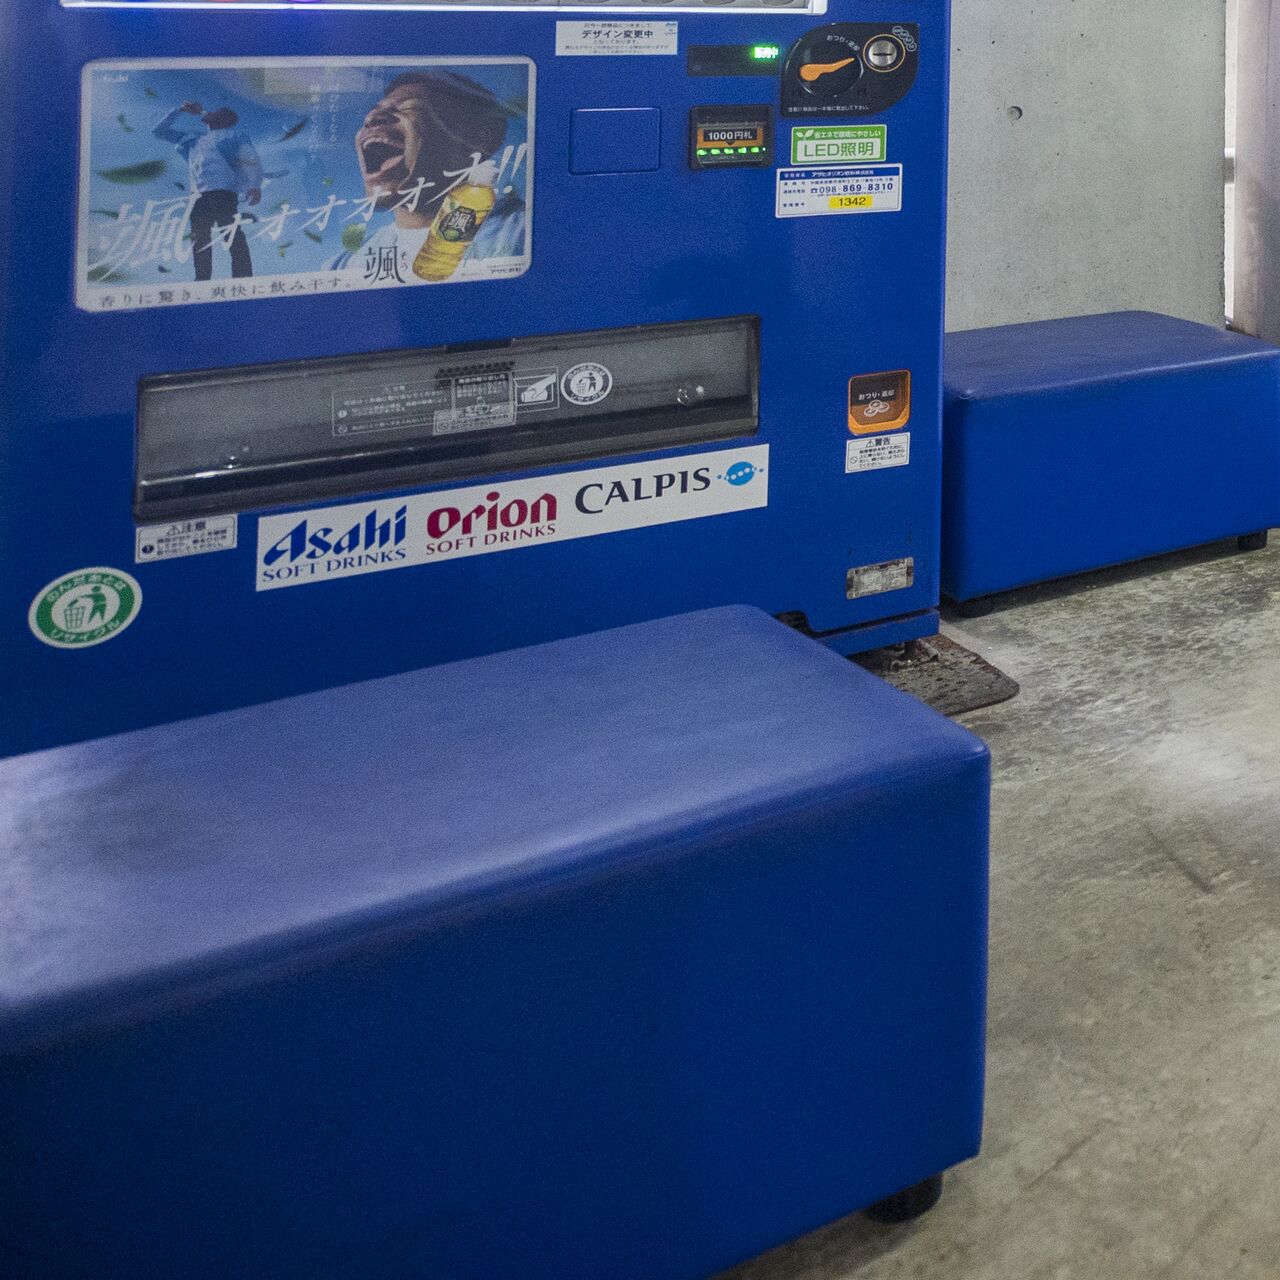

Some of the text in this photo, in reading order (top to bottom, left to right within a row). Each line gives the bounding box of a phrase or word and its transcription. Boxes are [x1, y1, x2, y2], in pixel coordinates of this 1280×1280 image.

[581, 29, 654, 39] デザイン変更中
[708, 128, 754, 141] 1000円札
[803, 141, 874, 158] LED照明
[839, 196, 867, 207] 1342
[363, 245, 406, 286] 颯
[100, 276, 352, 309] 香りに驚き、爽快に飲み干す。
[574, 467, 712, 515] CALPIS
[263, 504, 408, 567] Asahi
[425, 523, 557, 556] SOFT DRINKS
[262, 547, 408, 583] SOFT DRINKS
